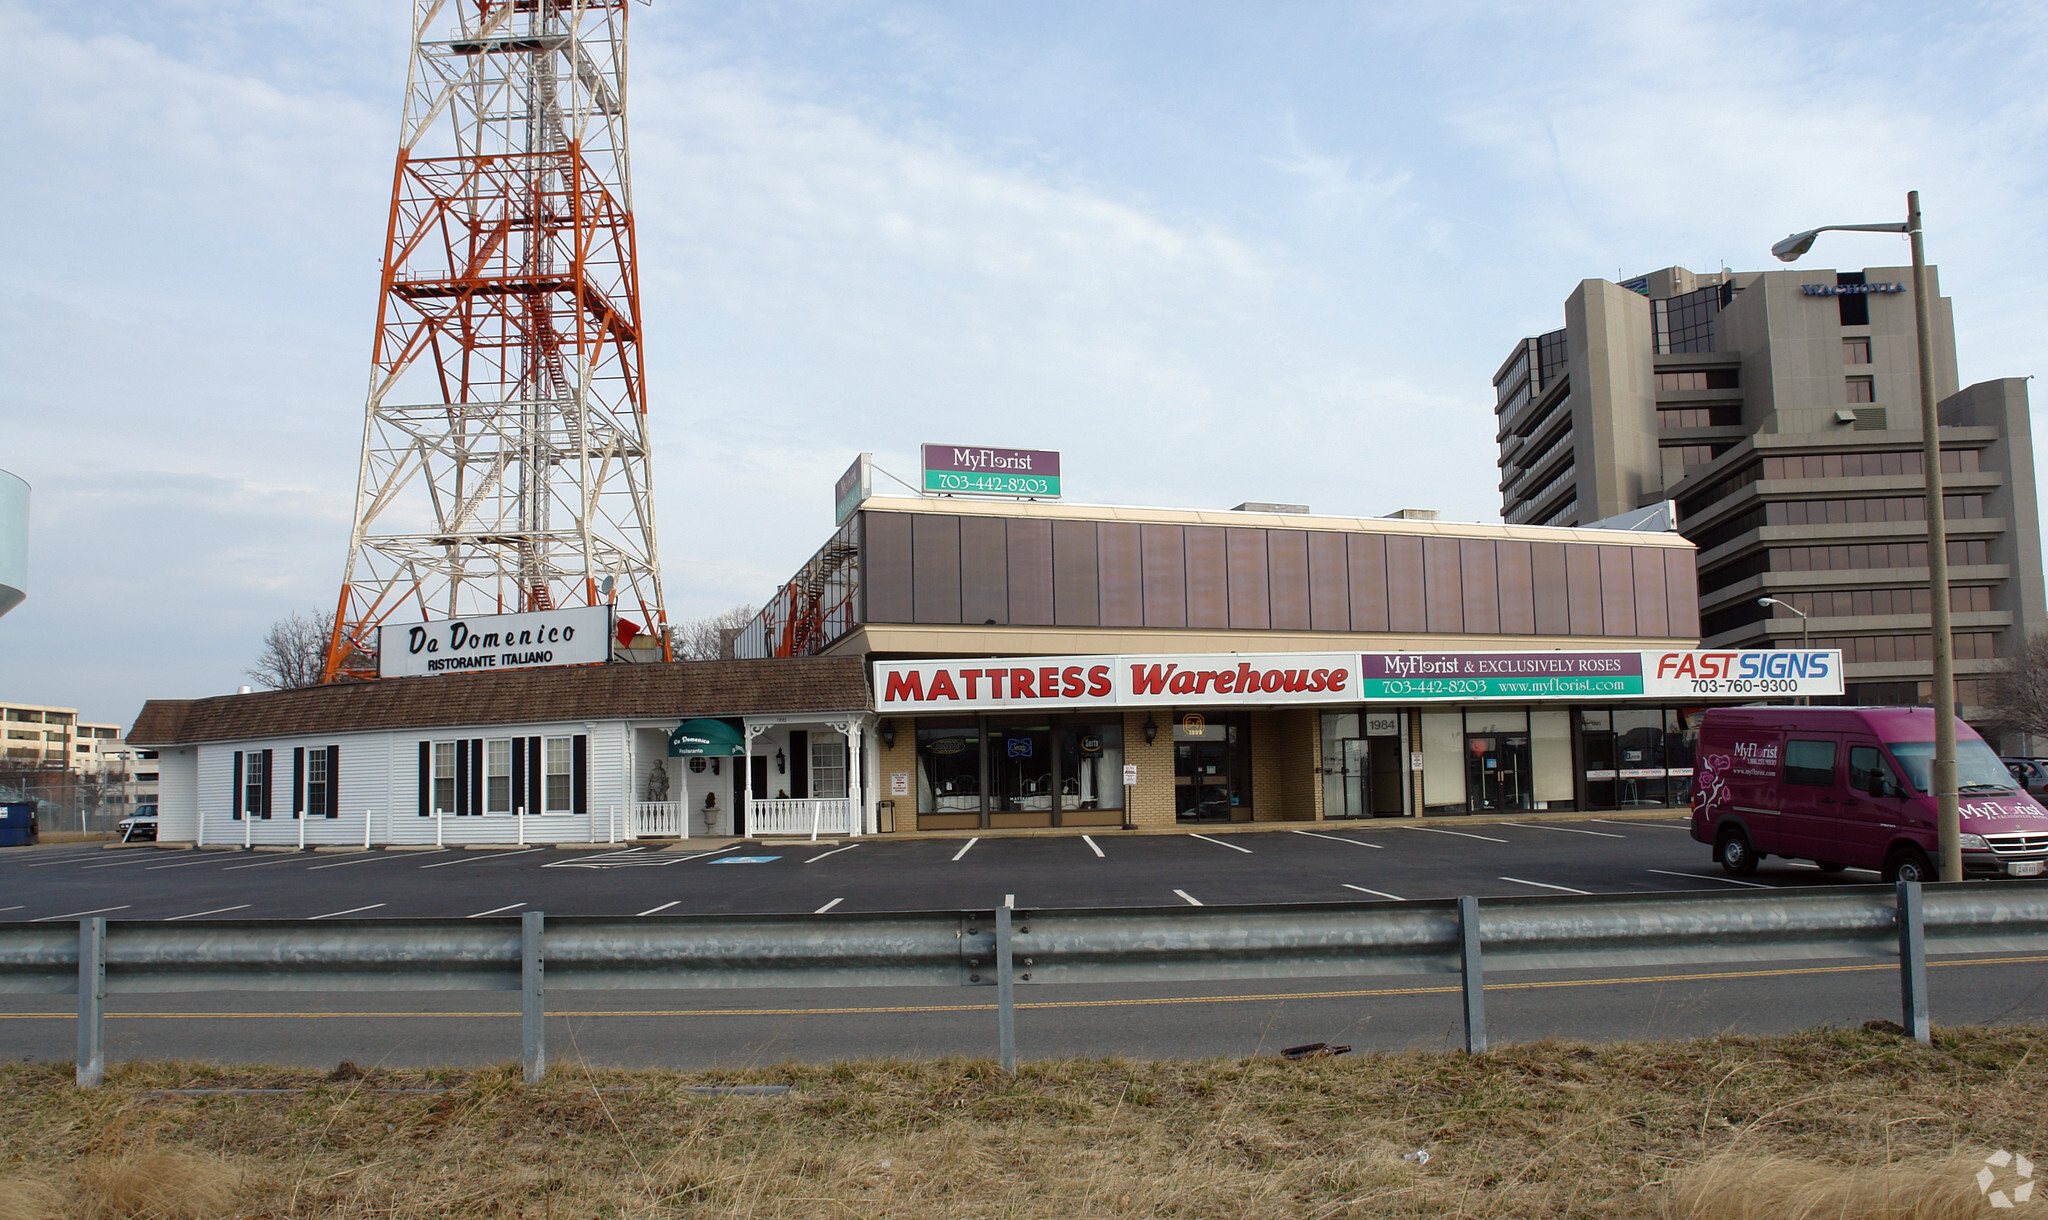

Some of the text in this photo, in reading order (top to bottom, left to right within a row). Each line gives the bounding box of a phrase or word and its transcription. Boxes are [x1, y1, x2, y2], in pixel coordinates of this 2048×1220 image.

[1801, 282, 1907, 296] WACHOVIA
[953, 448, 1033, 471] MyFlorist
[939, 474, 1048, 493] 703-442-8203
[409, 621, 575, 655] Da Domenico
[428, 650, 553, 671] RISTORANTE ITALIANO
[1384, 655, 1621, 678] MyFlorist & EXCLUSIVELY ROSES
[1657, 653, 1830, 679] FASTSIGNS
[885, 662, 1349, 701] MATTRESS Warehouse
[1382, 677, 1625, 696] 703-442-8203 www.myflorist.com
[1691, 679, 1798, 692] 703-760-9300
[1369, 719, 1395, 730] 1984
[1733, 742, 1778, 760] MyFlorist
